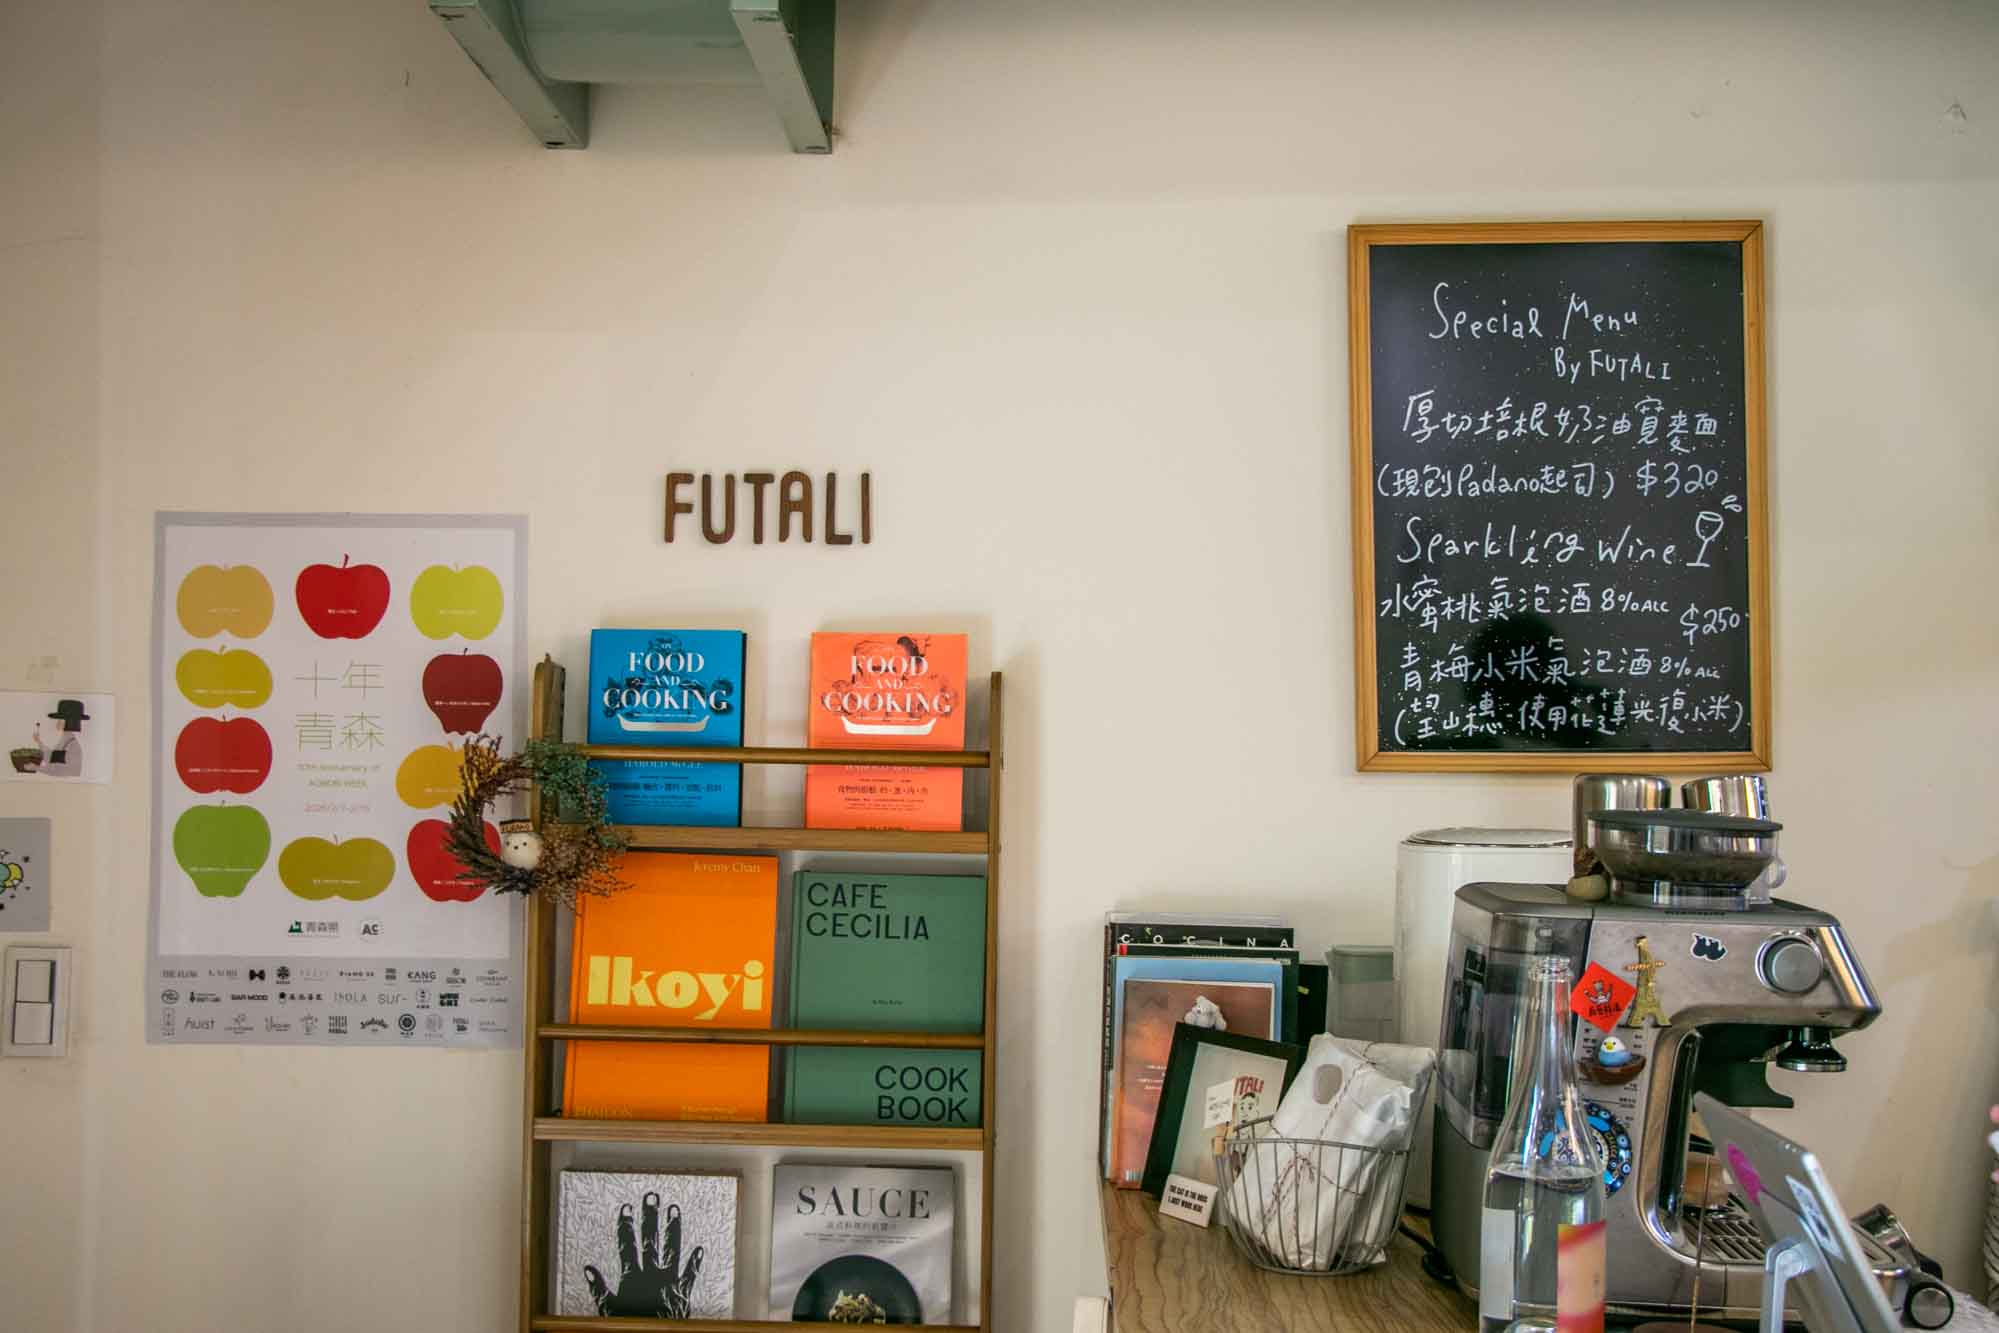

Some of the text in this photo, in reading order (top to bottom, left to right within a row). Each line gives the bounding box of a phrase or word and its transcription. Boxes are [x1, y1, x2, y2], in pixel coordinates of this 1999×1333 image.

[1429, 282, 1638, 340] Special Menu
[1555, 347, 1672, 383] By FUTALI
[1637, 460, 1718, 498] $320
[664, 471, 871, 545] FUTALI
[1397, 516, 1676, 565] Sparkling Wine
[1680, 603, 1741, 646] $250
[629, 651, 705, 673] FOOD
[851, 655, 928, 676] FOOD
[293, 659, 384, 700] 十年
[654, 676, 680, 686] AND
[603, 688, 728, 711] COOKING
[824, 691, 952, 713] COOKING
[295, 711, 384, 752] 青森
[807, 882, 888, 909] CAFE
[806, 912, 929, 940] CECILIA
[1119, 934, 1289, 948] COCINA
[587, 955, 765, 1020] Ikoyi
[874, 1065, 969, 1093] COOK
[877, 1095, 969, 1123] BOOK
[797, 1185, 929, 1218] SAUCE
